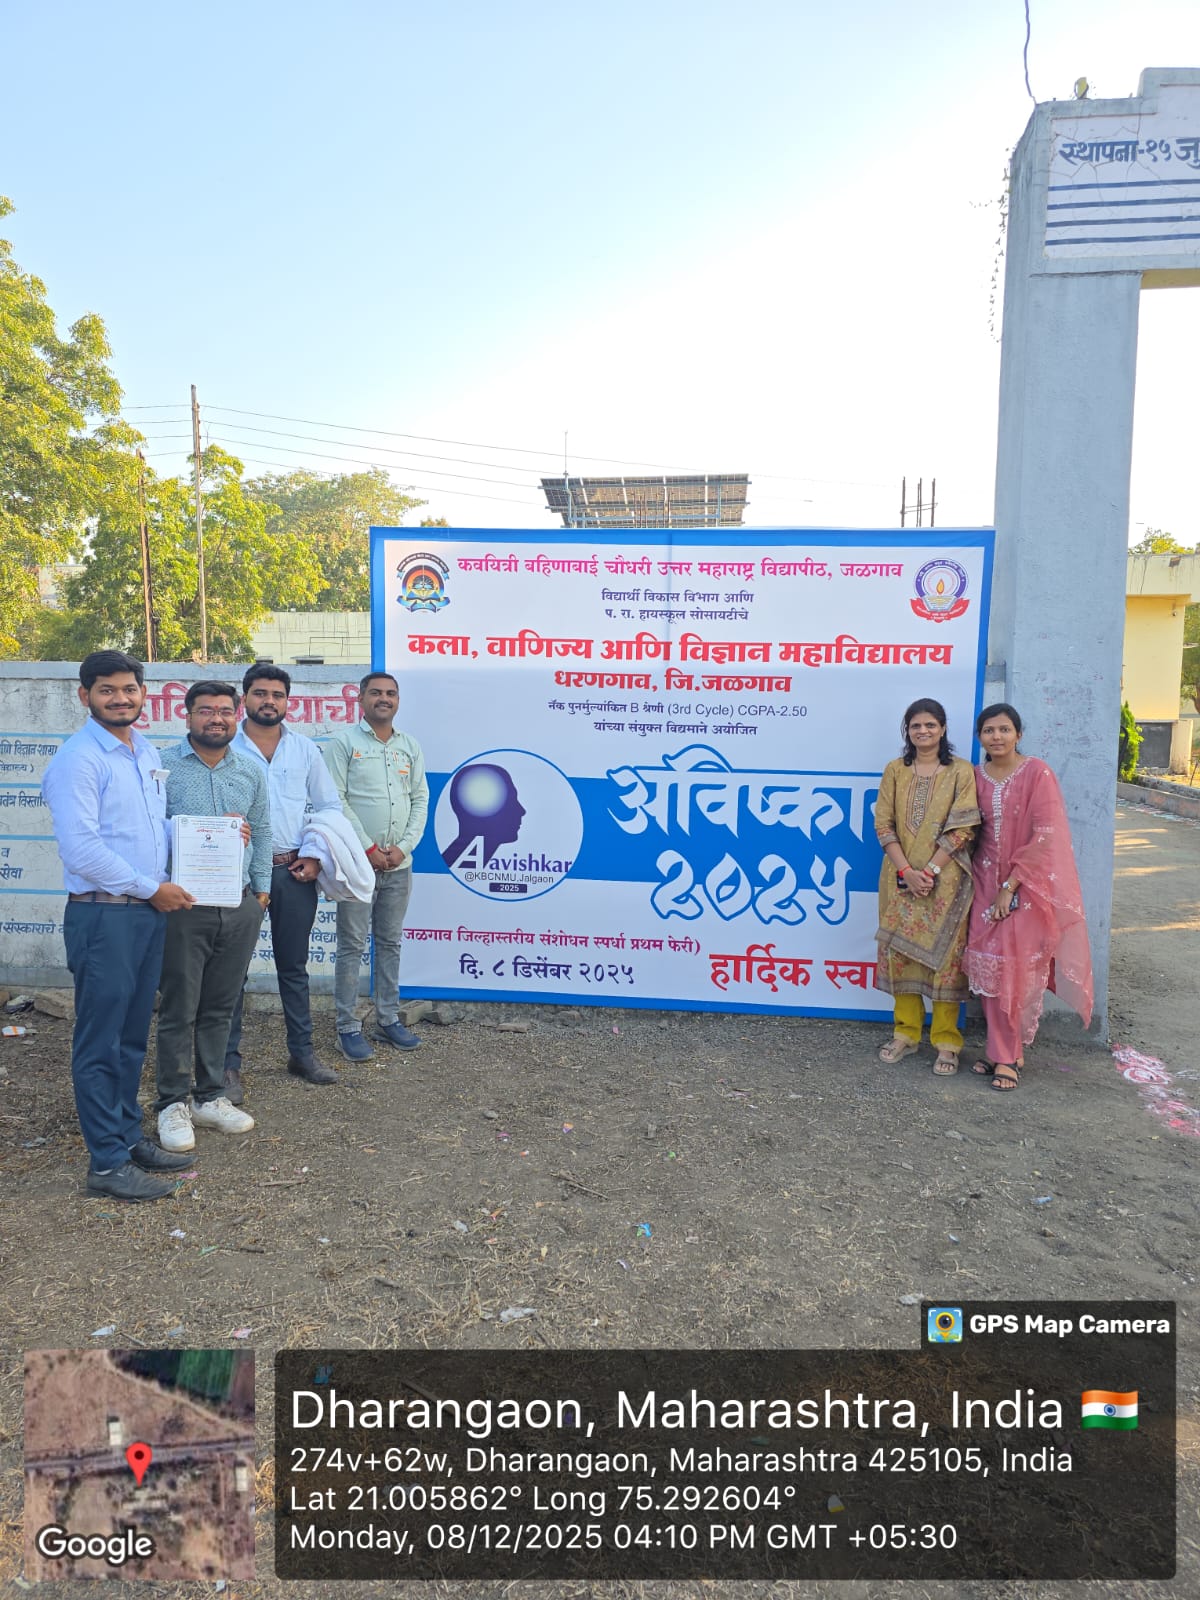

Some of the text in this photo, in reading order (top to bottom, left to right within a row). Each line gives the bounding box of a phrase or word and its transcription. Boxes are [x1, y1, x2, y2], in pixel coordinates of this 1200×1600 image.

[457, 553, 519, 574] कवयित्री
[524, 554, 599, 576] बहिणाबाई
[604, 555, 652, 575] चौधरी
[657, 561, 692, 576] उत्तर
[698, 561, 755, 581] महाराष्ट्र
[761, 557, 832, 580] विद्यापीठ,
[840, 563, 903, 577] जळगाव
[601, 588, 754, 603] विद्यार्थी विकास विभाग आणि
[605, 607, 749, 623] प. रा. हायस्कूल सोसायटीचे
[408, 629, 953, 667] कला, वाणिज्य आणि विज्ञान महाविद्यालय
[554, 668, 792, 693] धरणगाव, जि.जळगाव
[630, 702, 640, 713] B
[643, 702, 664, 714] श्रेणी
[668, 703, 691, 716] (3rd
[695, 704, 733, 719] Cycle)
[738, 705, 807, 717] CGPA-2.50
[594, 719, 625, 732] यांच्या
[628, 720, 662, 736] संयुक्त
[666, 721, 708, 734] विद्यमाने
[499, 884, 520, 893] 2025
[650, 849, 852, 925] २०२५
[401, 926, 701, 955] जळगाव जिल्हास्तरीय संशोधन स्पर्धा प्रथम फेरी)
[459, 952, 635, 984] दि. ८ डिसेंबर २०२५
[709, 943, 813, 992] हार्दिक
